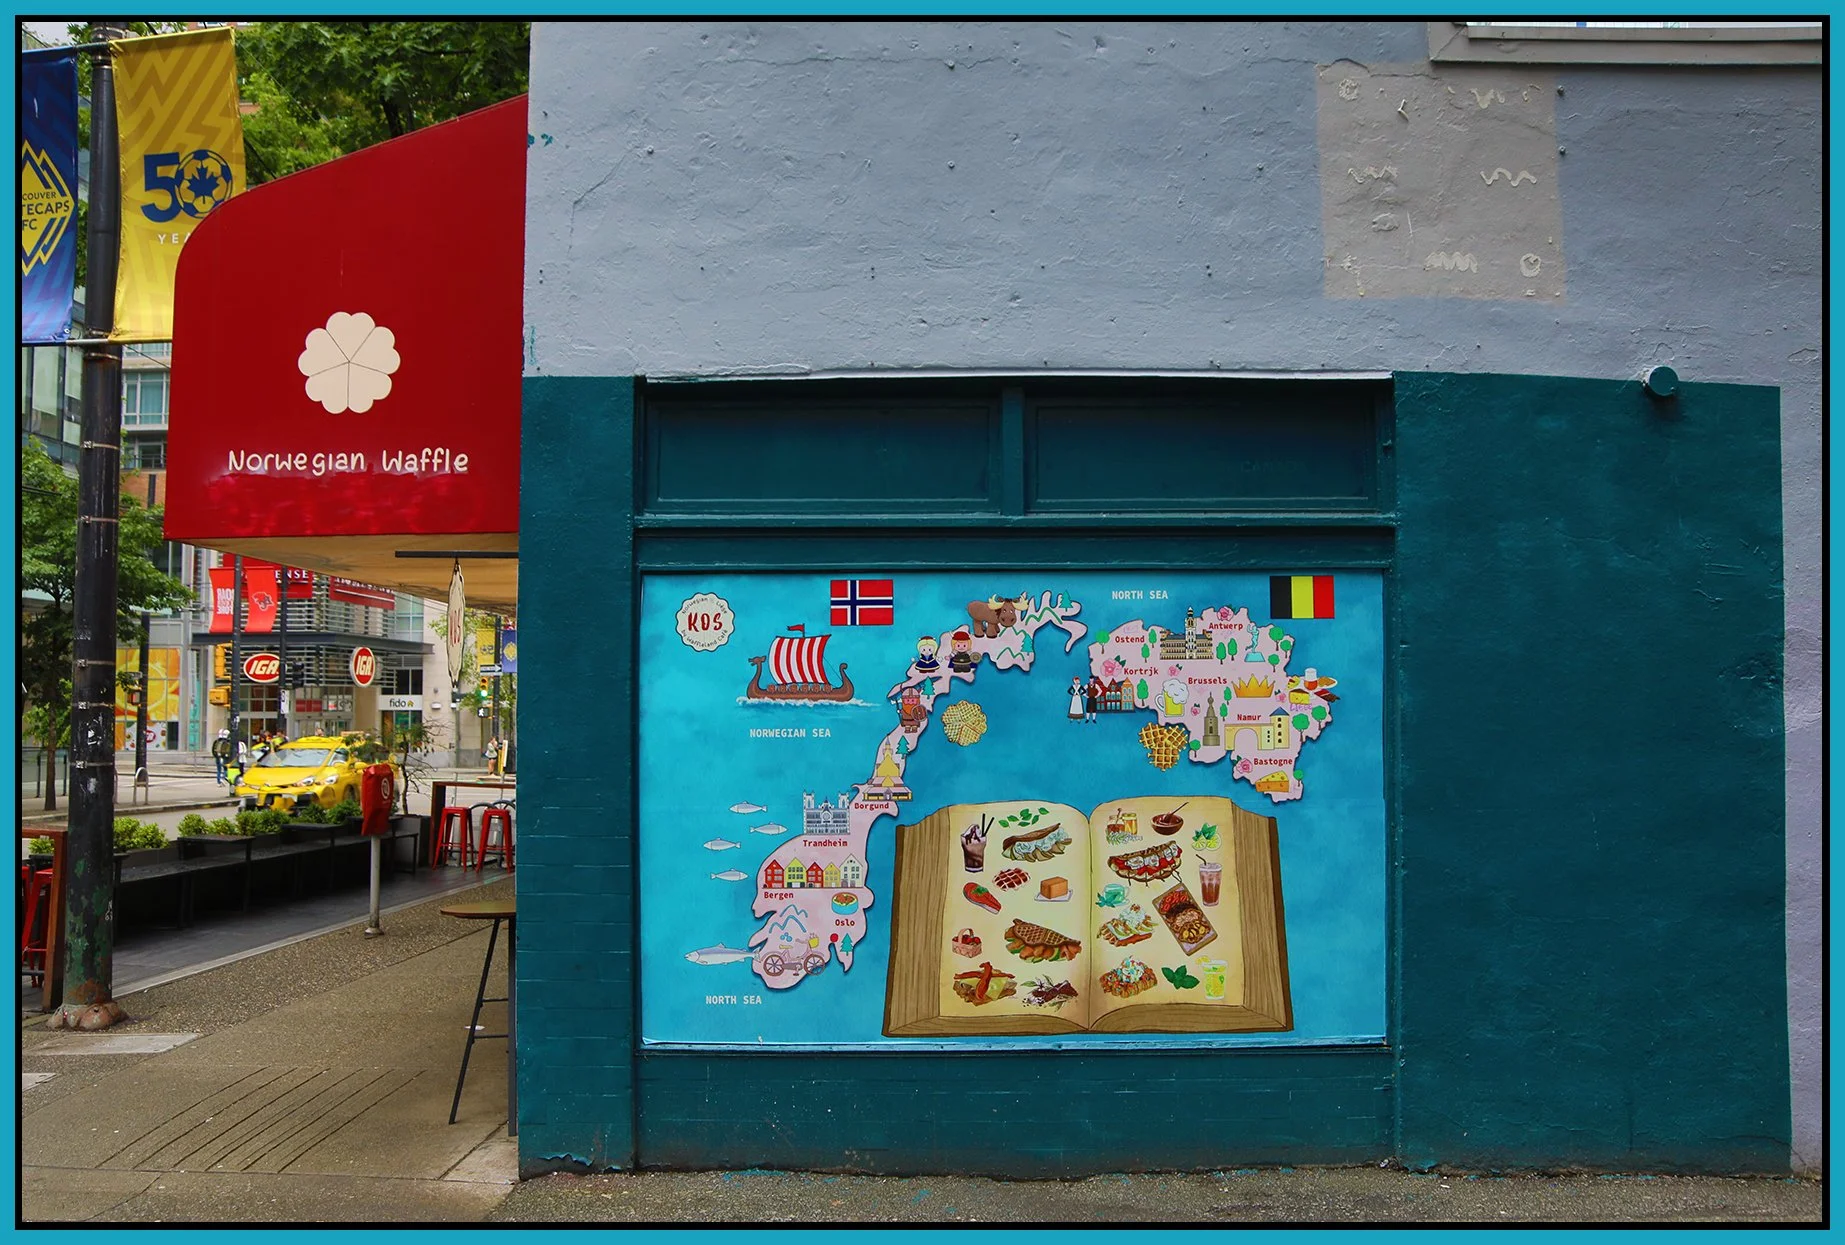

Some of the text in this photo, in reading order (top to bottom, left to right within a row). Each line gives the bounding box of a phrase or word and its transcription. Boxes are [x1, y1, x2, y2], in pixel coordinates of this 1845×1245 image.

[228, 447, 469, 476] Norwegian Waffle
[1111, 590, 1169, 600] NORTH SEA
[687, 612, 723, 632] KOS
[1209, 622, 1243, 631] Antwerp
[1115, 635, 1145, 643] Ostend
[249, 660, 278, 675] IGA
[355, 655, 374, 676] IGA
[1188, 676, 1227, 685] Brussels
[389, 697, 407, 708] fido
[1237, 713, 1262, 721] Namur
[749, 728, 831, 738] NORWEGIAN SEA
[1254, 757, 1293, 767] Bastogne
[854, 802, 889, 811] Borgund
[803, 839, 848, 847] Trandheim
[764, 892, 793, 901] Bergen
[835, 919, 855, 927] Oslo
[705, 995, 762, 1005] NORTH SEA
